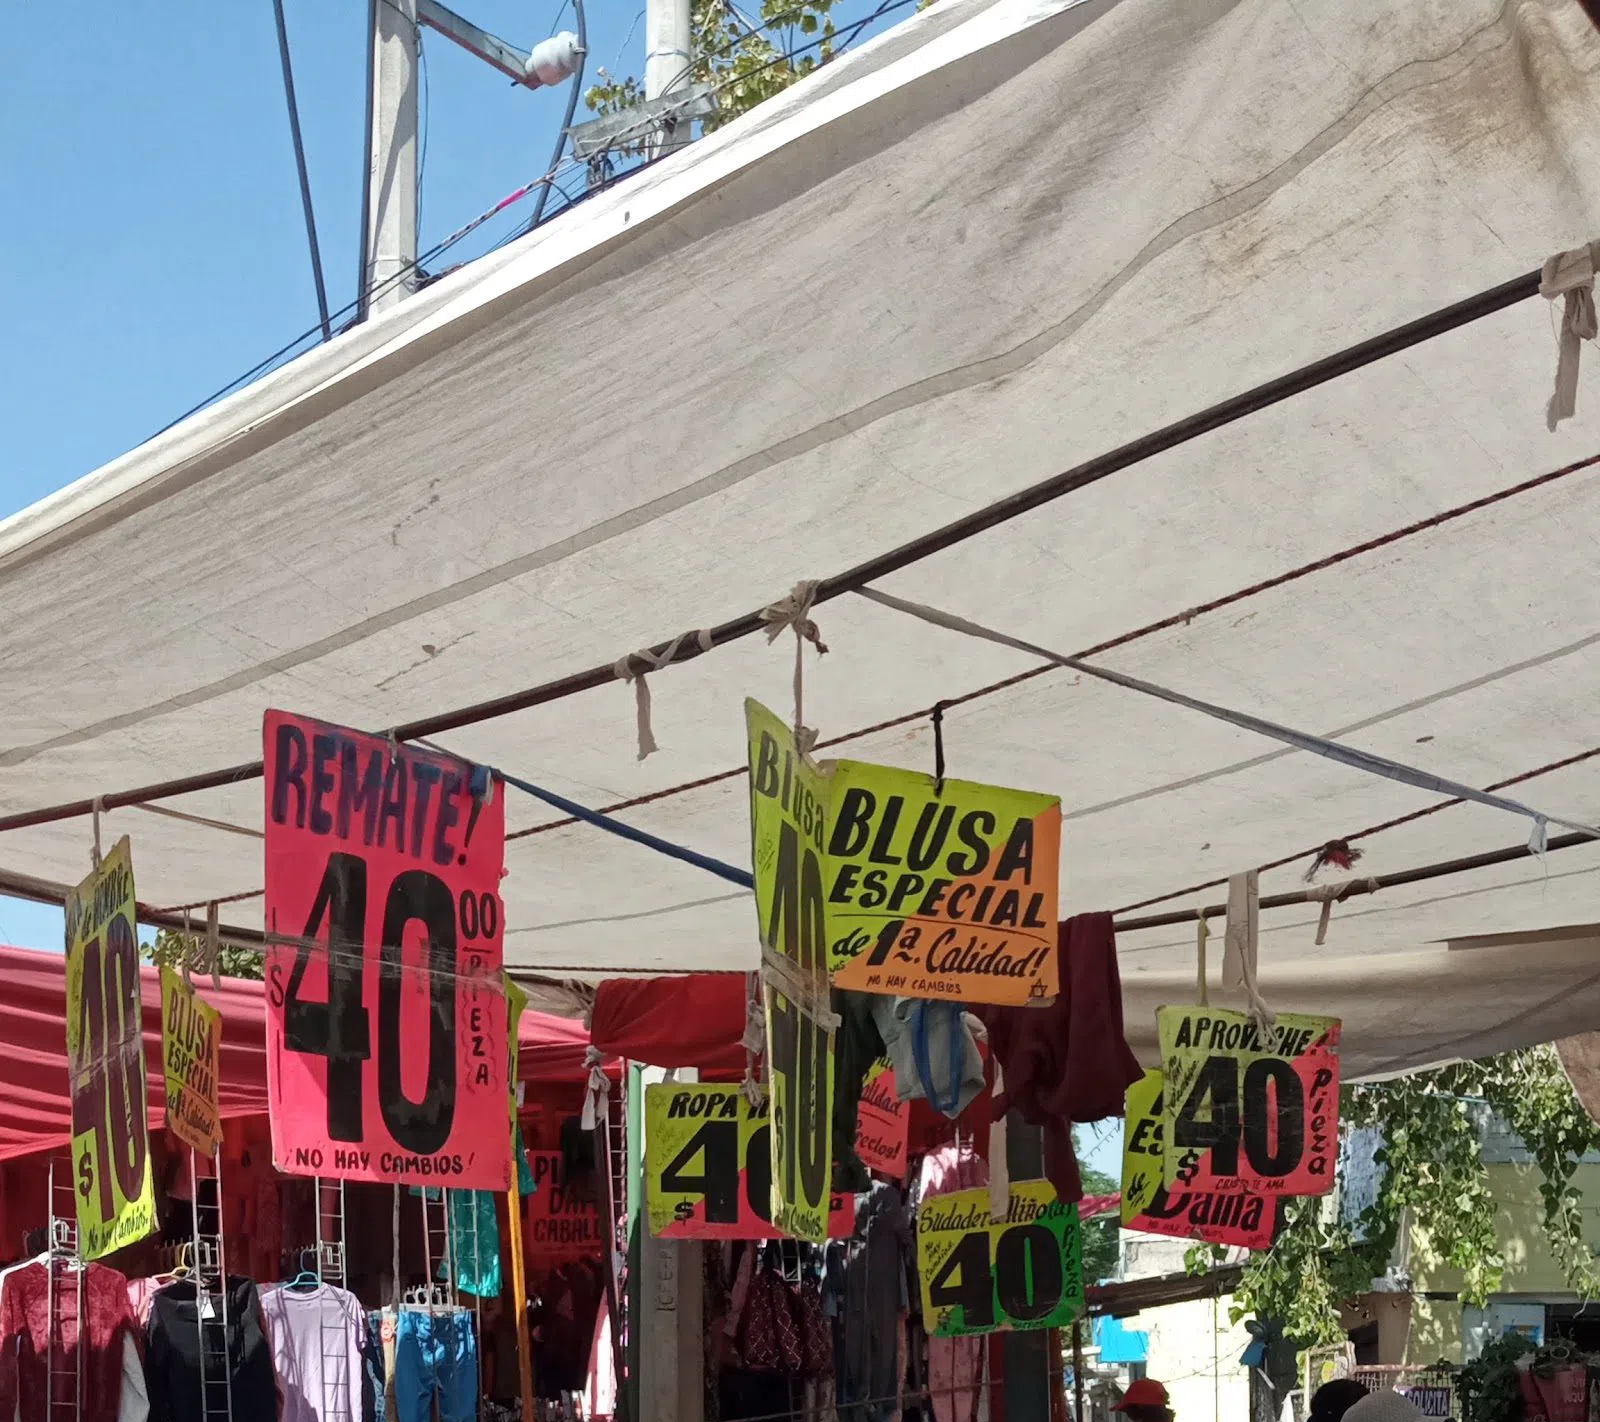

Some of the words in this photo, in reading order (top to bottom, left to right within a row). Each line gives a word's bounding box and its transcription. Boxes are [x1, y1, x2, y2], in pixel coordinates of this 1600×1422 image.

[271, 724, 484, 866] REMATE!
[756, 730, 825, 855] Blusa
[828, 787, 1034, 886] BLUSA
[828, 863, 1050, 929] ESPECIAL
[832, 927, 871, 957] de
[925, 927, 1051, 978] Calidad!
[866, 974, 882, 987] NO
[167, 987, 214, 1068] BLUSA
[284, 852, 456, 1155] 40
[167, 1040, 214, 1103] ESPECIAL
[667, 1092, 738, 1120] ROPA
[1174, 1056, 1305, 1177] 40
[335, 1150, 370, 1171] HAY
[381, 1151, 475, 1175] CAMBIOS!
[1176, 1149, 1200, 1187] $
[919, 1202, 1002, 1234] Sudader
[929, 1224, 1063, 1327] 40
